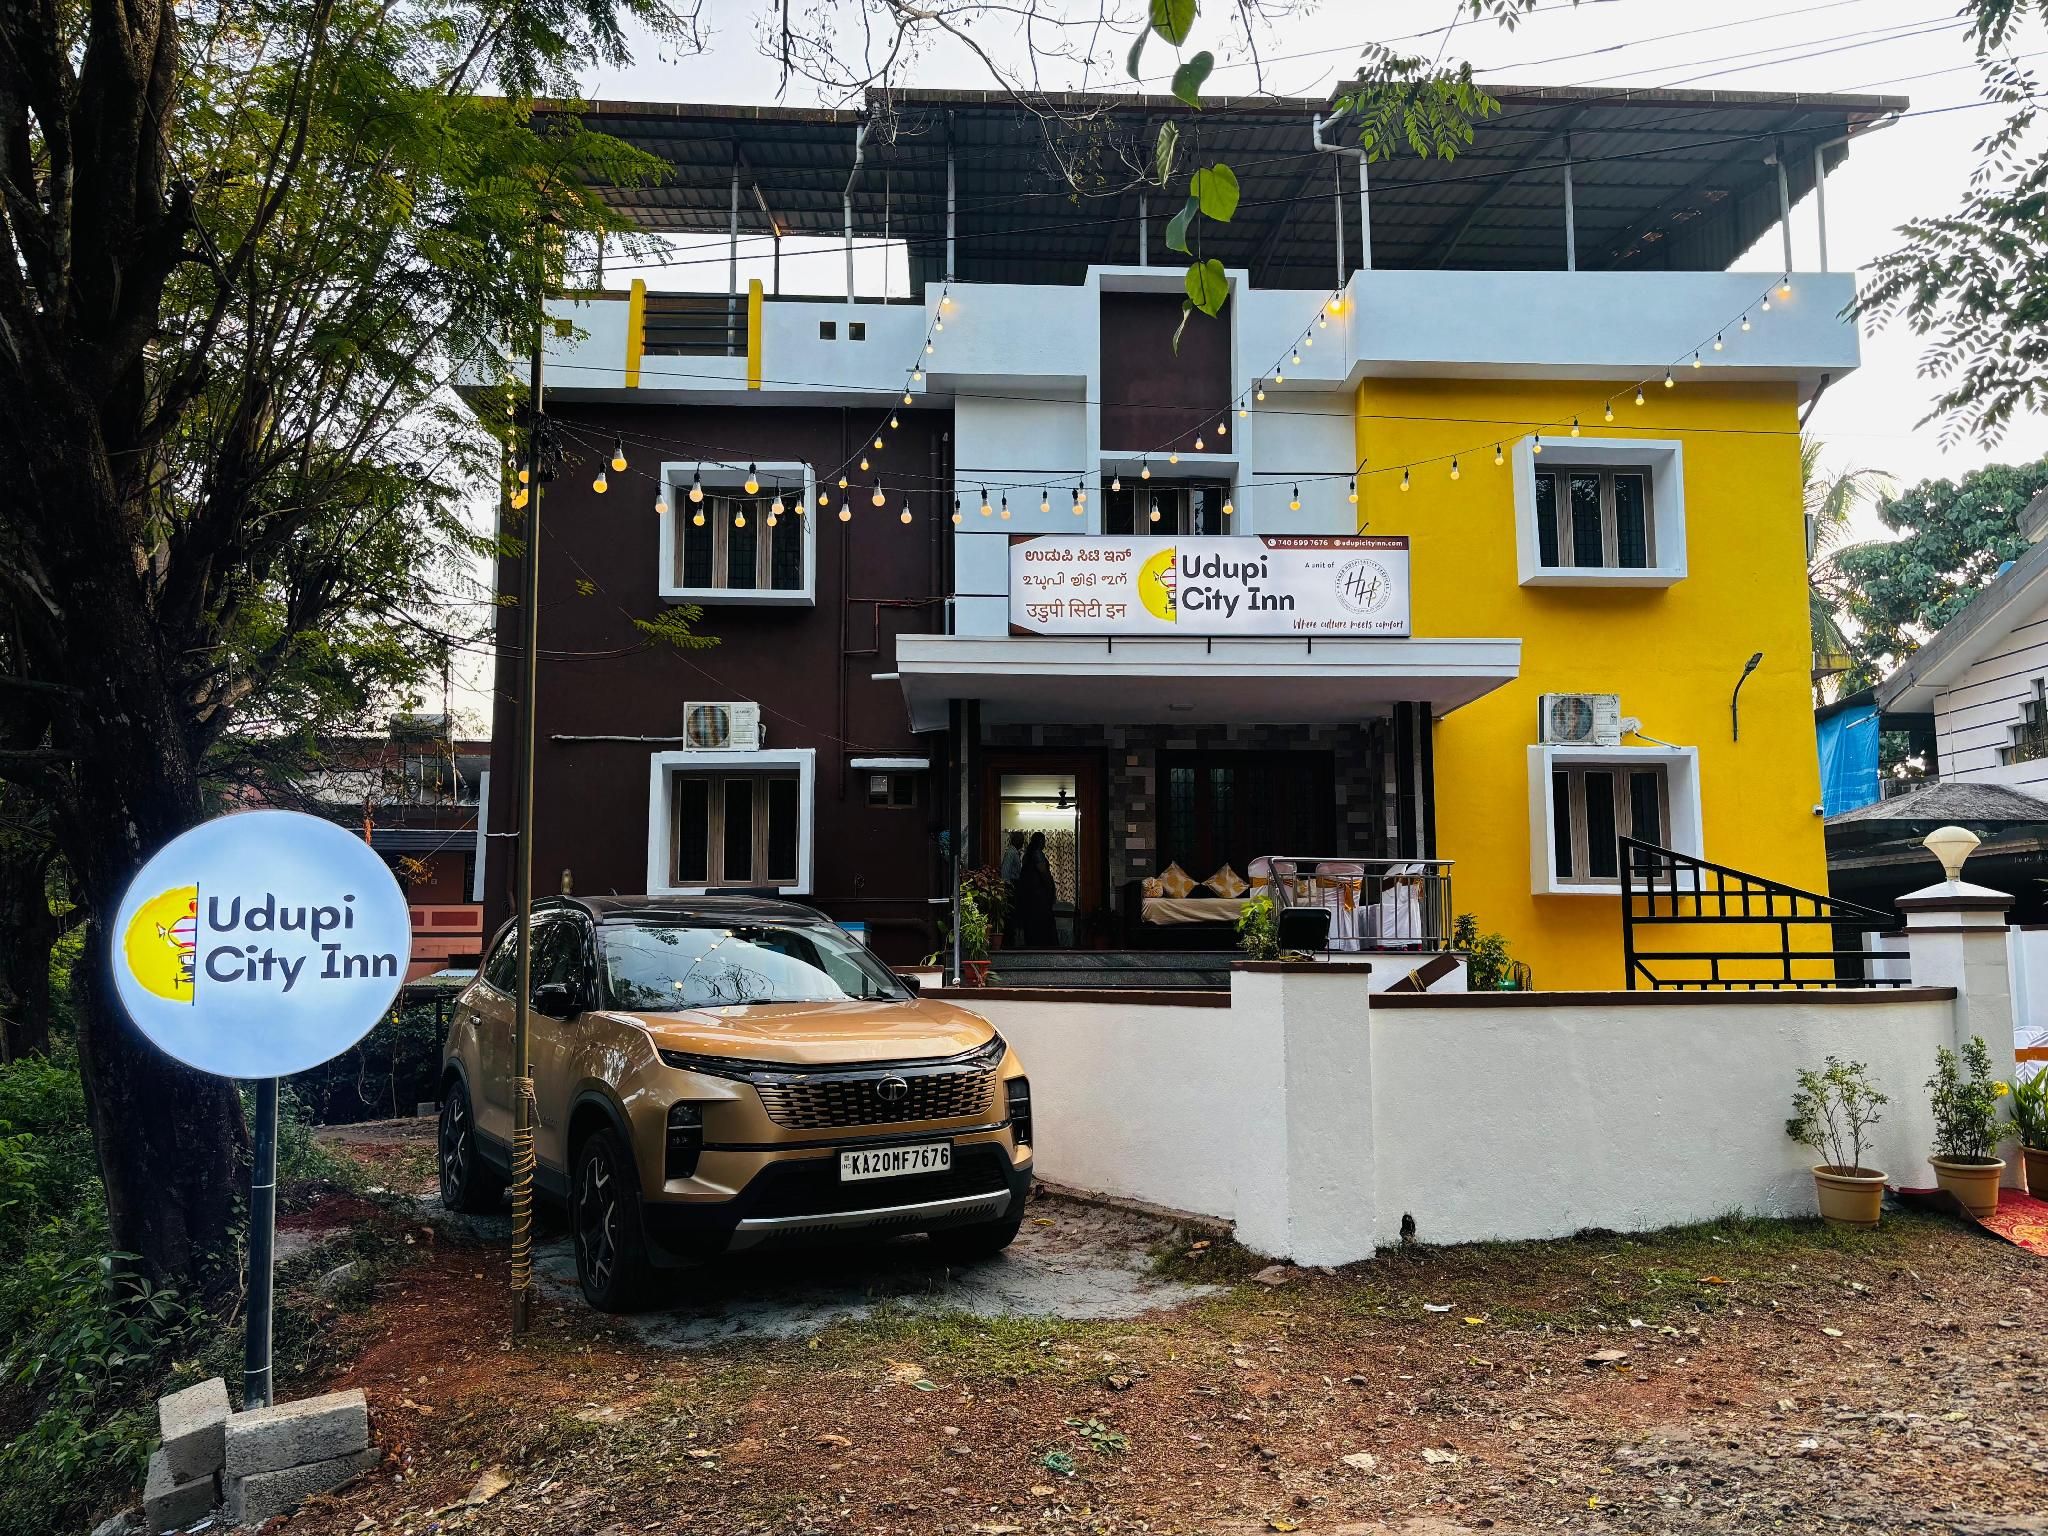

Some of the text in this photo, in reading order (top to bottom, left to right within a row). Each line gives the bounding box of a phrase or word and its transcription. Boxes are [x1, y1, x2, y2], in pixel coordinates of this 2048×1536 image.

[1025, 548, 1132, 563] ಉಡುಪಿ ಸಿಟಿ ಇನ್
[1182, 553, 1268, 586] Udupi
[1311, 561, 1326, 569] unit
[1025, 598, 1128, 623] उडुपी सिटी इन
[1181, 586, 1295, 619] City Inn
[1293, 617, 1404, 630] Where culture meets comfort
[208, 892, 356, 943] Udupi
[205, 943, 398, 993] City Inn
[852, 1147, 949, 1175] KA20MF7676
